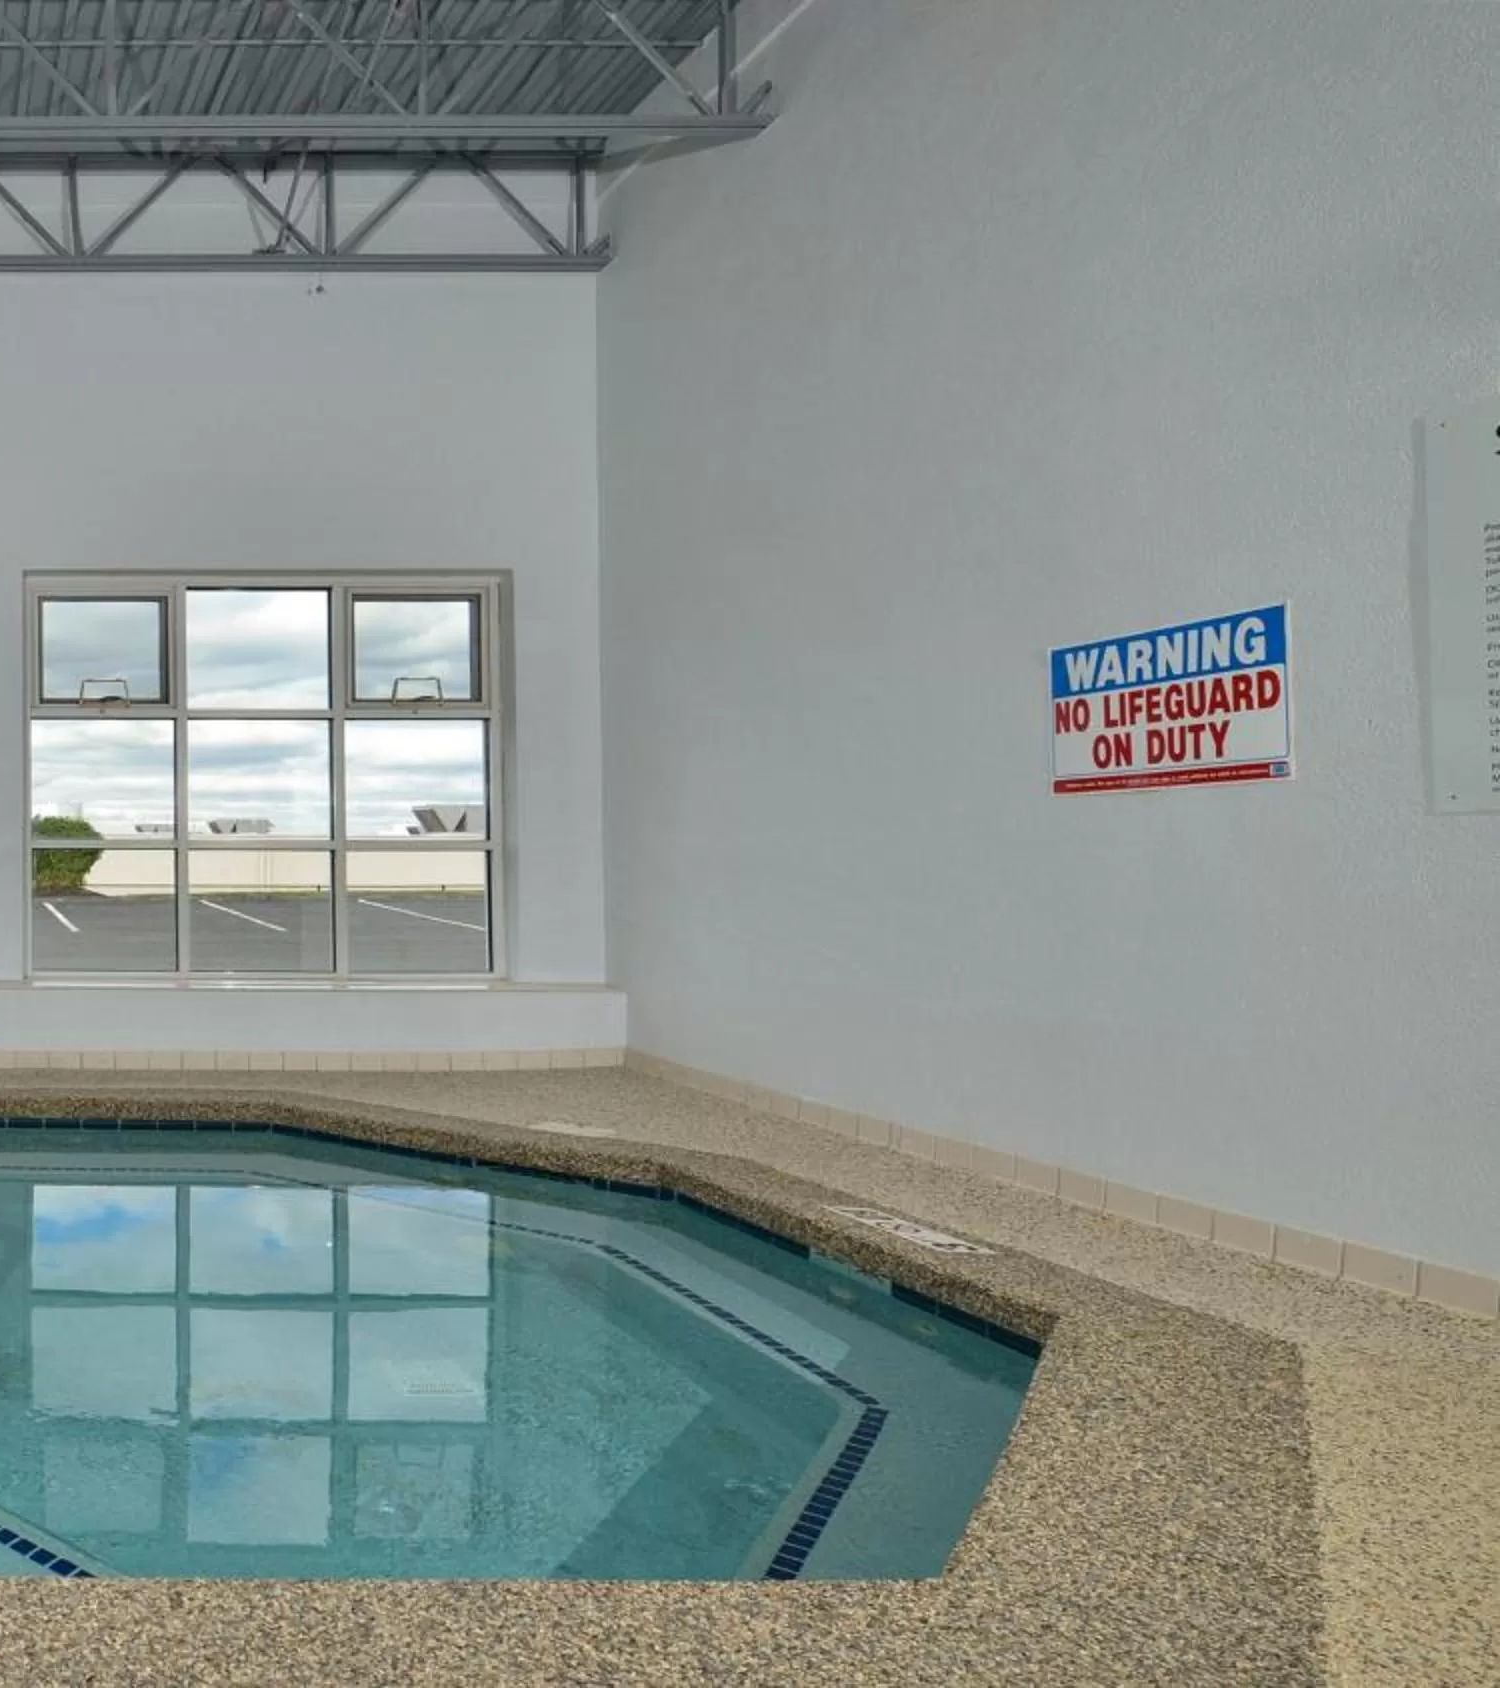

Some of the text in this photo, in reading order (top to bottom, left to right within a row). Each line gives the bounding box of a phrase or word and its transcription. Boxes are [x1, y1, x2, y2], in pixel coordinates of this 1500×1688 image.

[1064, 616, 1267, 692] WARNING
[1055, 669, 1281, 735] NO LIFEGUARD
[1092, 719, 1231, 769] ON DUTY
